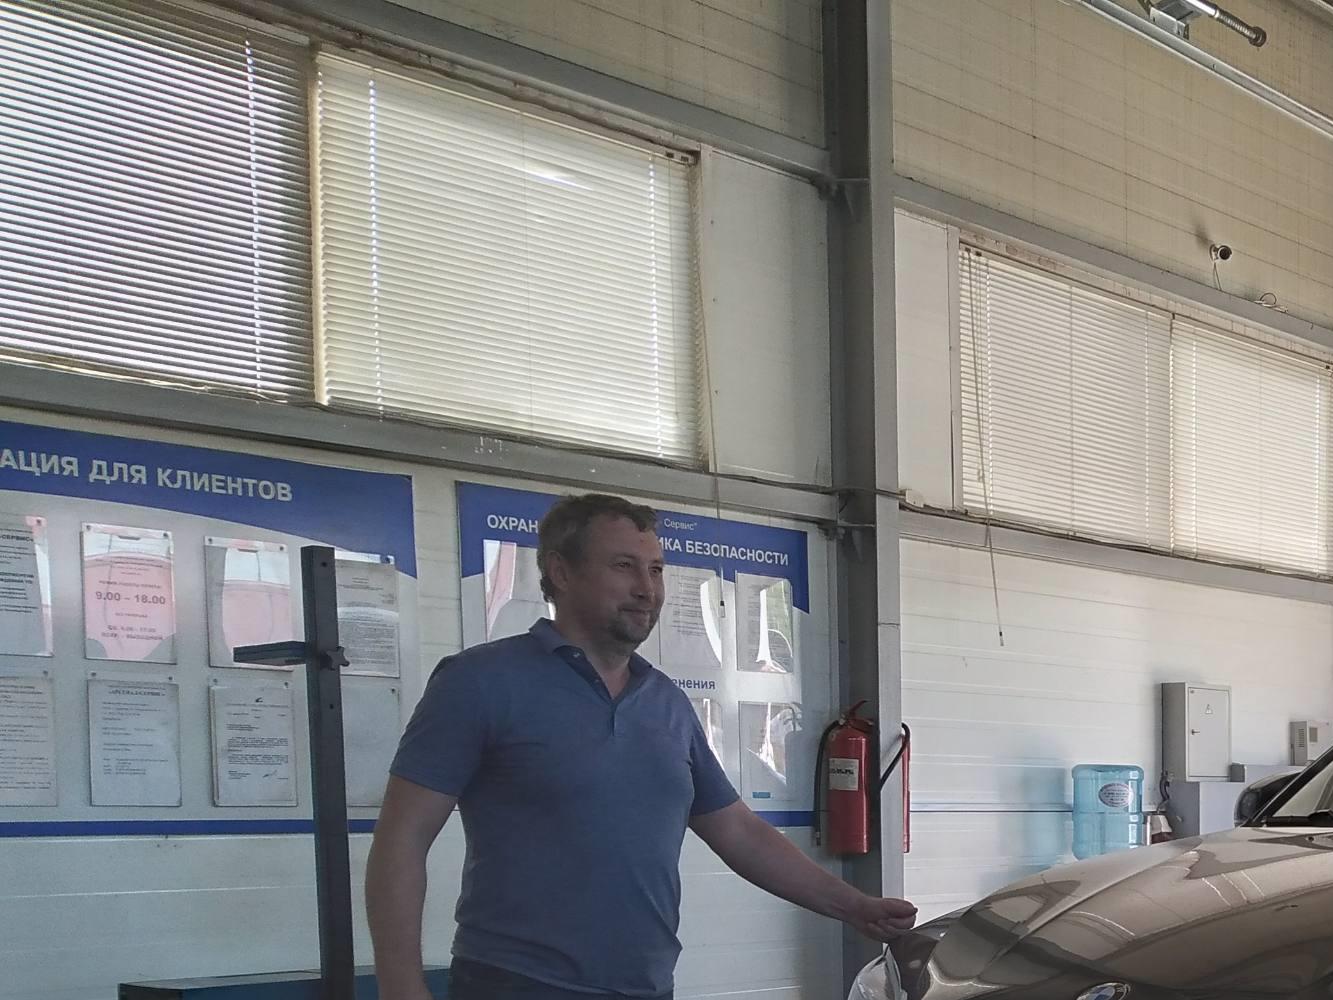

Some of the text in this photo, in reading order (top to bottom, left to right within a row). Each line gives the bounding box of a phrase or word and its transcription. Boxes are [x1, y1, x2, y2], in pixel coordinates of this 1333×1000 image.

[0, 448, 293, 502] АЦИЯ ДЛЯ КЛИЕНТОВ
[487, 514, 539, 533] ОХРАН
[685, 540, 789, 566] БЕЗОПАСНОСТИ
